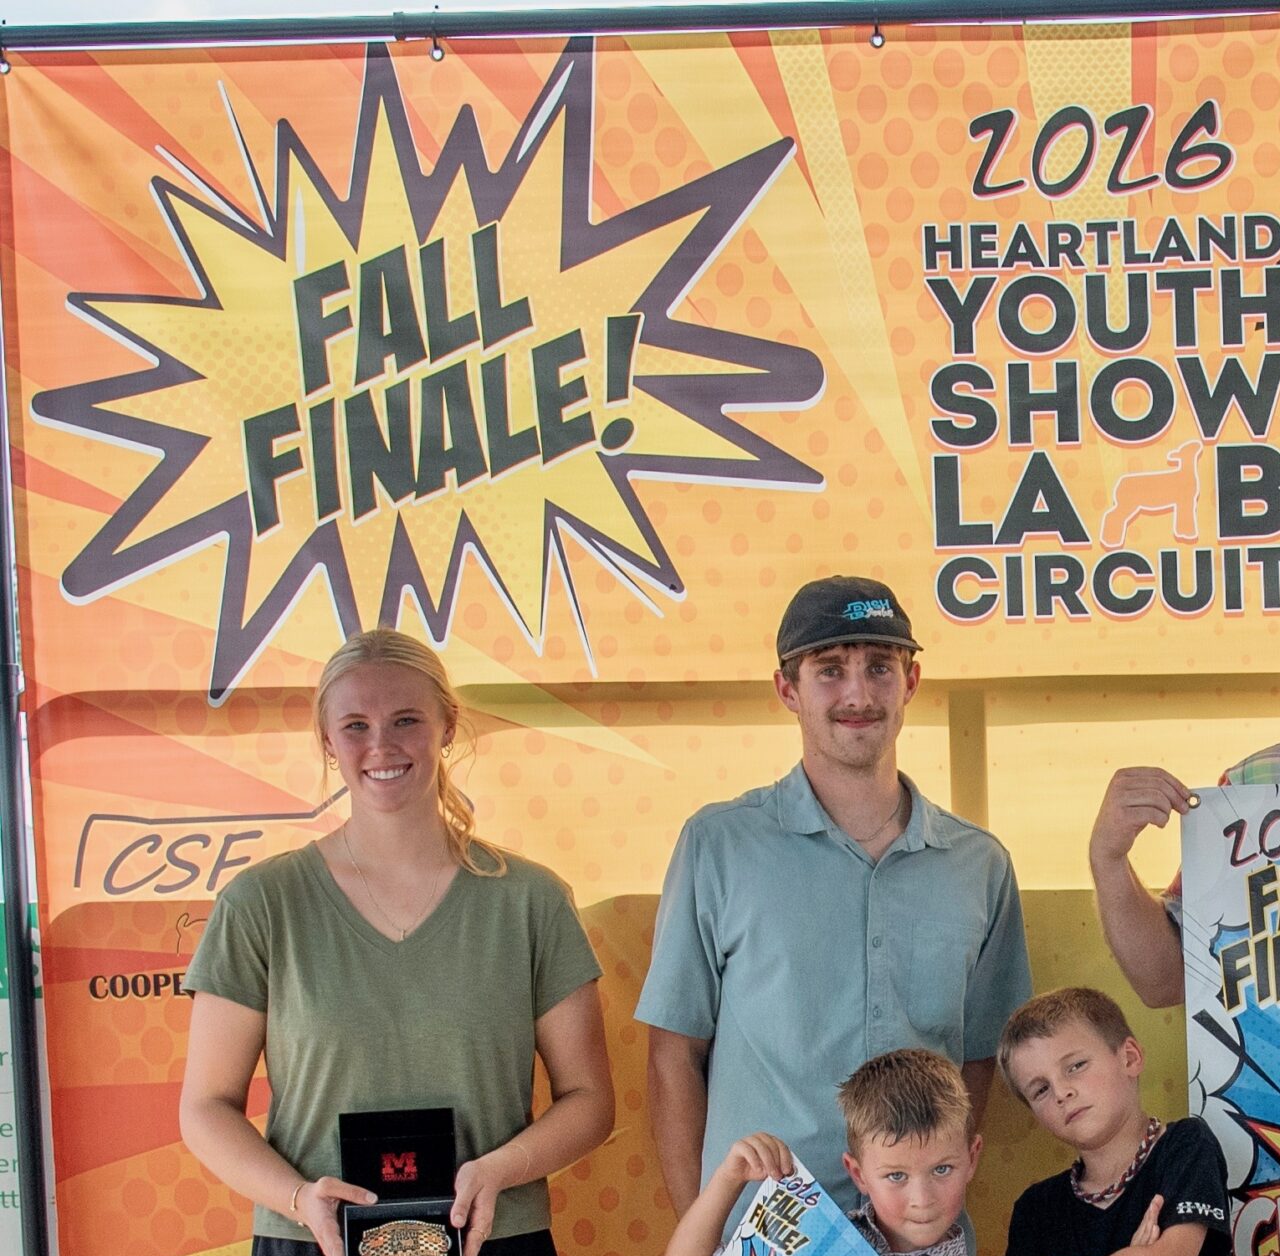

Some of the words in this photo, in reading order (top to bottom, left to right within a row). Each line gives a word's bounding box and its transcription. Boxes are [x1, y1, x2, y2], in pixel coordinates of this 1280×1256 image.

[969, 98, 1236, 199] 2026
[293, 222, 535, 400] FALL
[240, 312, 645, 538] FINALE!
[102, 829, 264, 896] CSF
[88, 971, 188, 1000] COOPE
[749, 1202, 811, 1256] FINALE!
[765, 1187, 808, 1228] FALL
